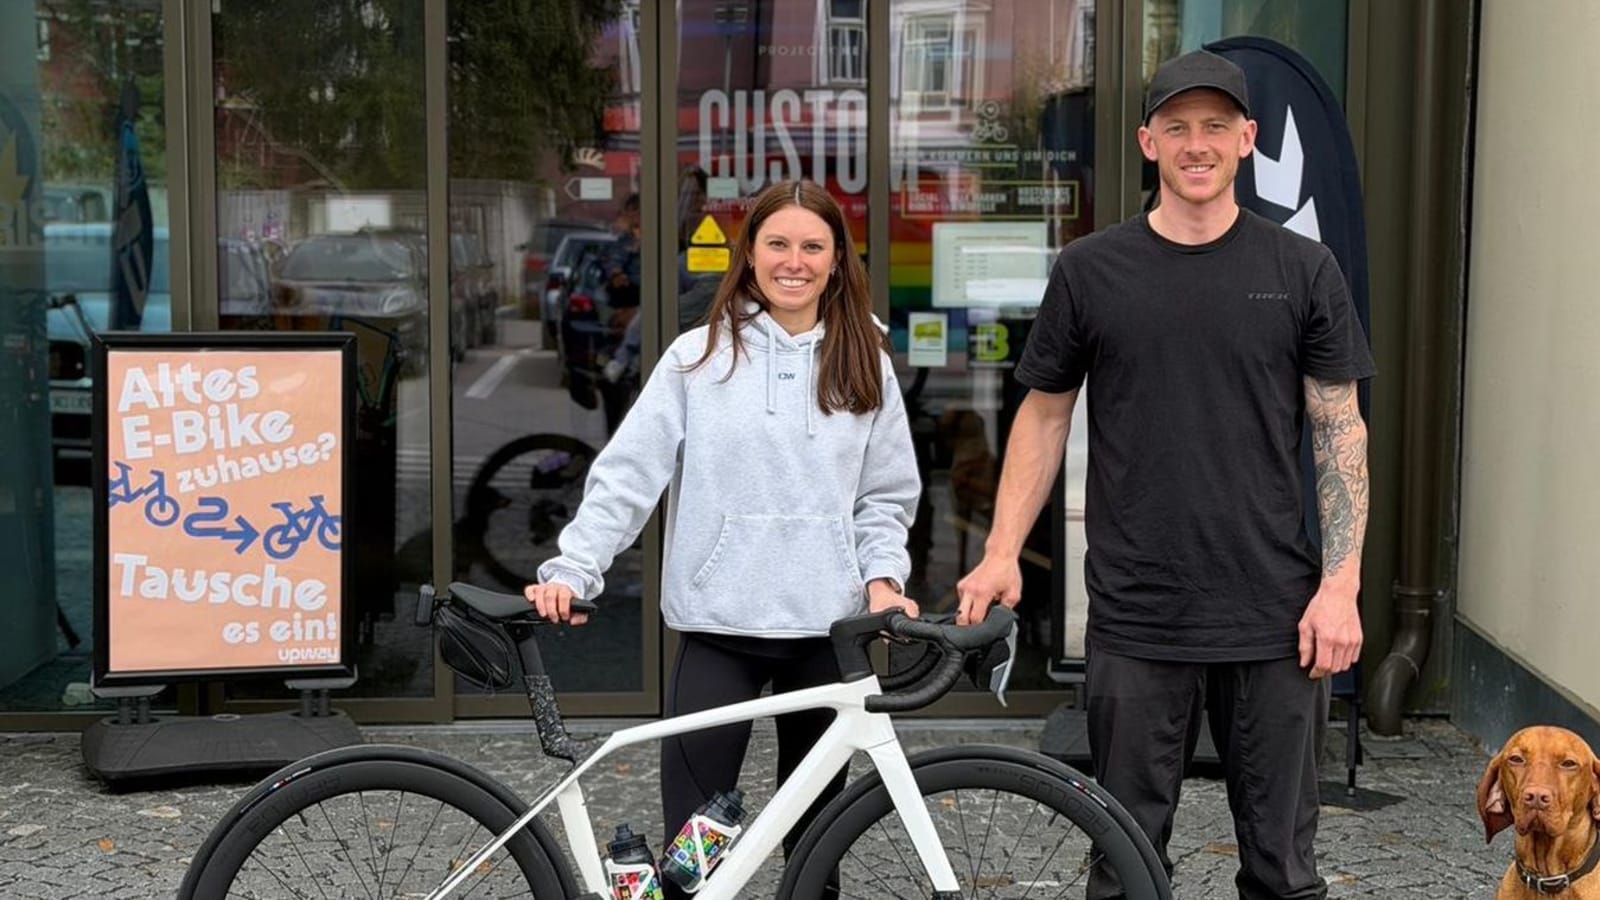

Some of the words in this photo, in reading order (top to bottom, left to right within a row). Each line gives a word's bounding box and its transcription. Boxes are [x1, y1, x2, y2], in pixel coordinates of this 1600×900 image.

[1047, 151, 1076, 161] DICH
[118, 362, 260, 412] Altes
[122, 404, 294, 460] E-Bike
[176, 432, 337, 493] zuhause?
[113, 552, 327, 612] Tausche
[222, 620, 259, 644] es
[269, 613, 337, 643] ein!
[278, 647, 338, 663] upway
